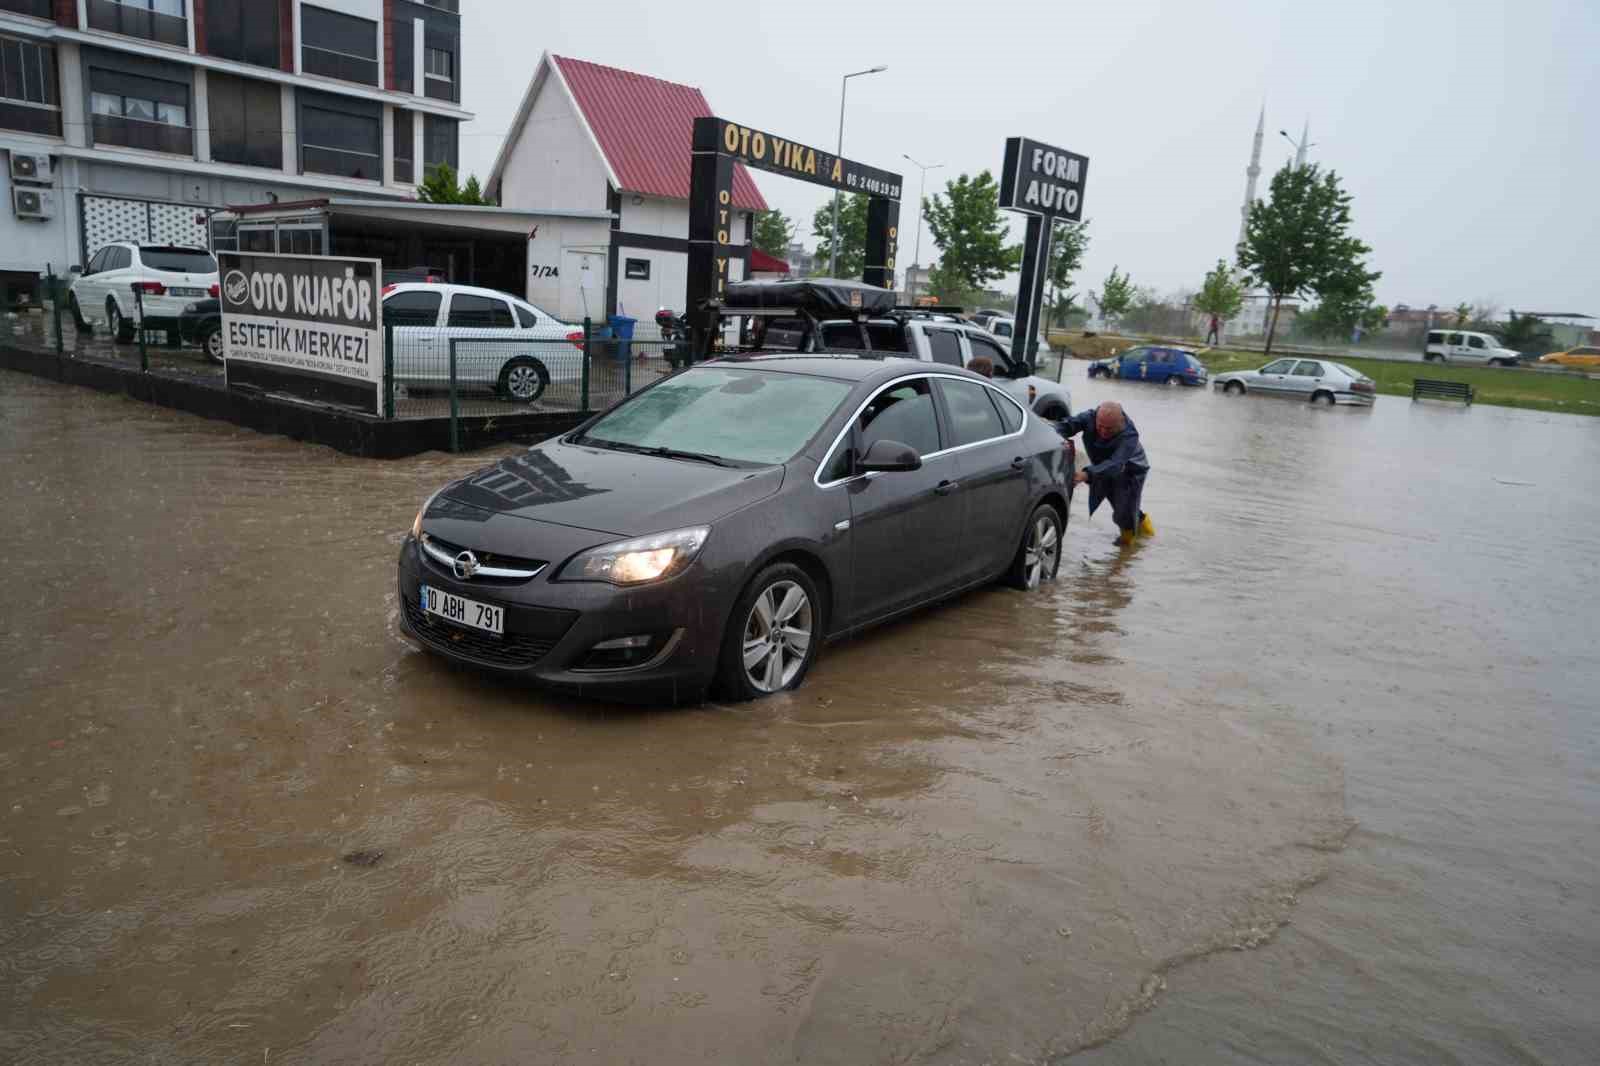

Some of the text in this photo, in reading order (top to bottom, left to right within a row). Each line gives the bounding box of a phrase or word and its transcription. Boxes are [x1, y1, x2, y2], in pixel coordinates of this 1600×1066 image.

[725, 124, 766, 159] OTO
[1032, 149, 1080, 183] FORM
[718, 190, 730, 245] OTO
[1025, 180, 1079, 214] AUTO
[887, 227, 897, 270] OTO
[532, 265, 559, 278] 7/24
[251, 267, 372, 322] OTO KUAFÖR
[229, 320, 291, 352] ESTETİK
[295, 328, 370, 364] MERKEZİ
[428, 589, 500, 631] 10 ABH 791
